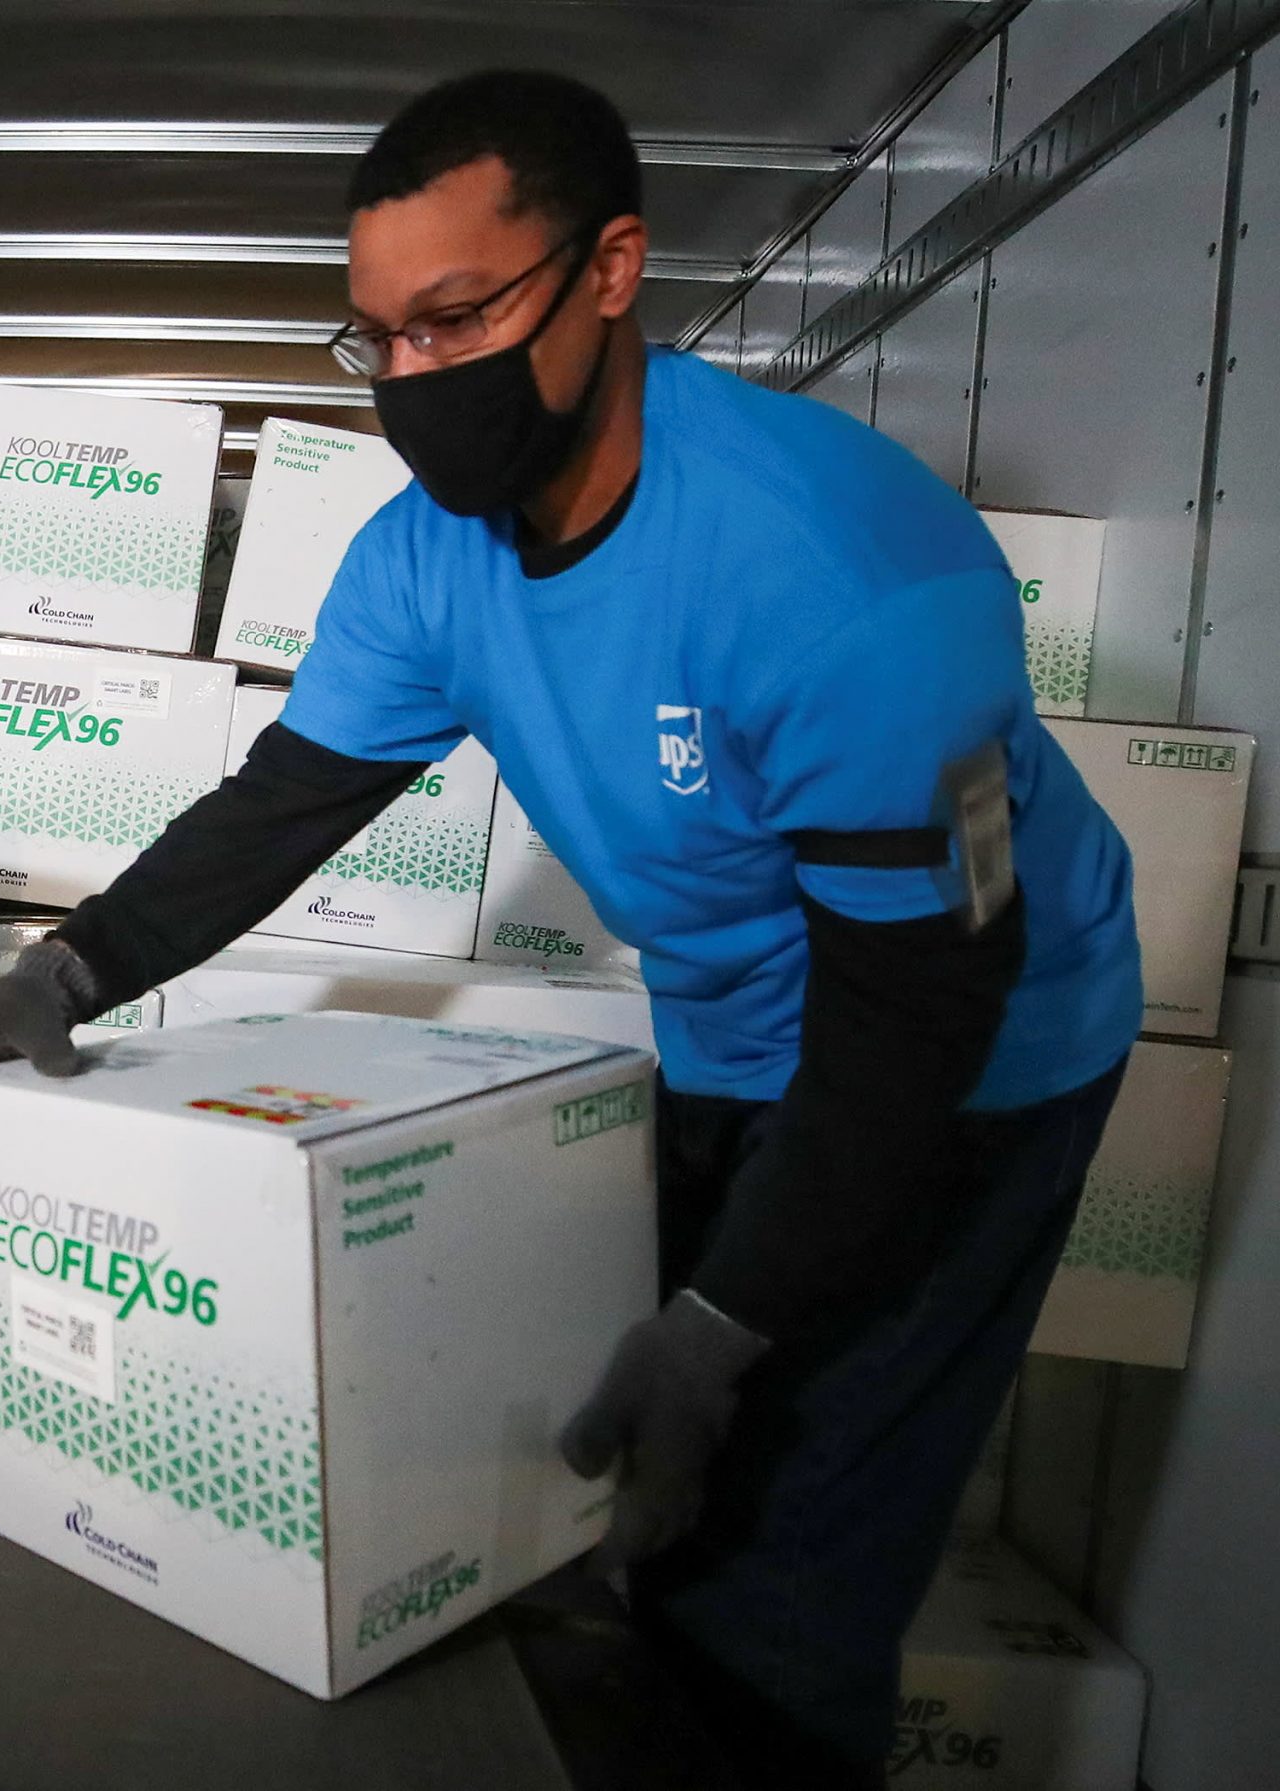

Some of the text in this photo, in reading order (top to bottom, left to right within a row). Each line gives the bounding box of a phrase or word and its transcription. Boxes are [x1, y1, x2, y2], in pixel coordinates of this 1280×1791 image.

[7, 436, 129, 465] KOOLTEMP
[277, 443, 330, 461] Sensitive
[274, 457, 320, 474] Product
[42, 607, 94, 622] COLD CHAIN
[241, 619, 307, 639] KOOLTEMP
[235, 629, 312, 657] ECOFLEX
[0, 868, 29, 880] CHAIN
[322, 908, 376, 922] COLD CHAIN
[498, 922, 566, 940] KOOLTEMP
